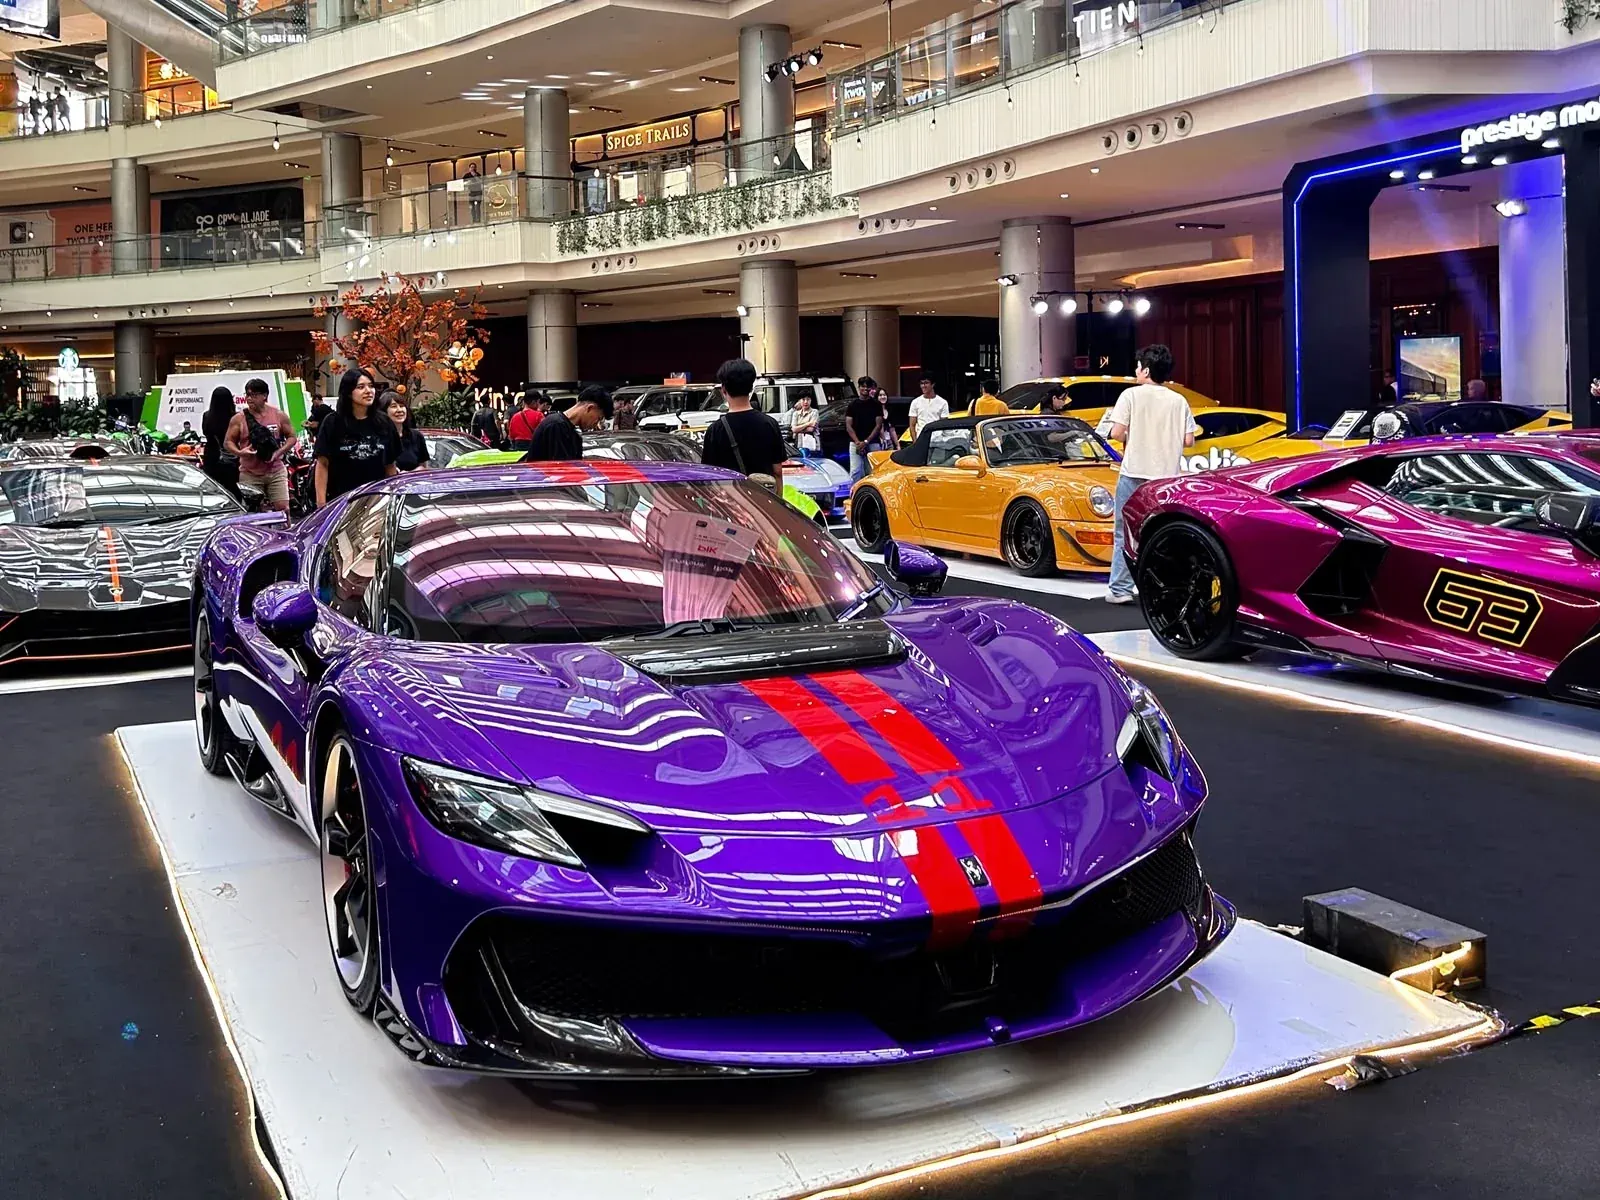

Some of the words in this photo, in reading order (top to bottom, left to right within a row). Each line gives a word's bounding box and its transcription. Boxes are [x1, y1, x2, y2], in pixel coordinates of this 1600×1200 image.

[1073, 0, 1136, 38] TIEN
[1461, 111, 1556, 153] prestige
[1560, 99, 1600, 127] mo
[607, 133, 643, 150] SPICE
[645, 123, 689, 144] TRAILS
[251, 210, 270, 221] JADE
[74, 224, 94, 234] ONE
[174, 387, 198, 395] ADVENTURE
[175, 396, 204, 404] PERFORMANCE
[1424, 568, 1543, 647] 63
